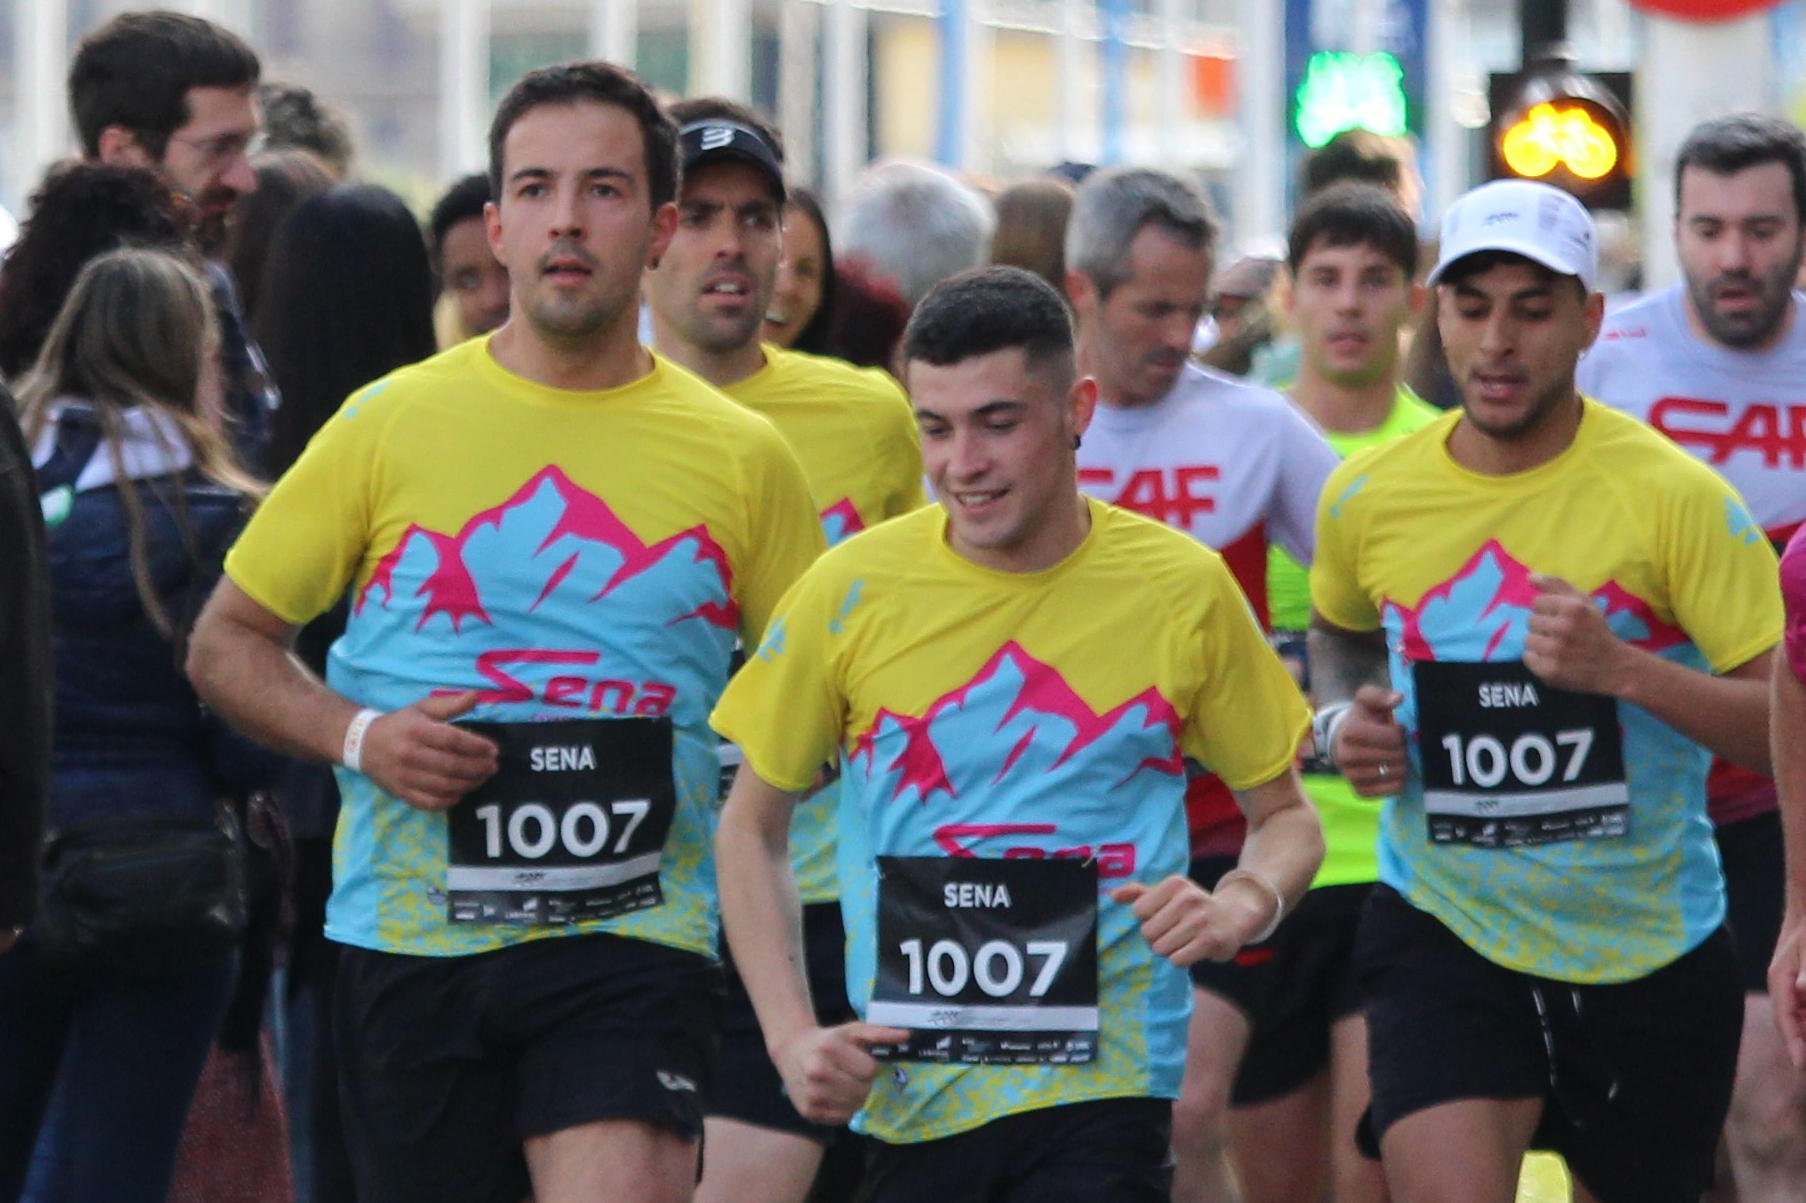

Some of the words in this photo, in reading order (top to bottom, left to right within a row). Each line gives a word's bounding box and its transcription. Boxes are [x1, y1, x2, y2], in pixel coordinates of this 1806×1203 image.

[1077, 465, 1220, 529] AF
[431, 649, 678, 716] Sena
[1478, 682, 1539, 708] SENA
[530, 745, 596, 771] SENA
[1442, 729, 1595, 788] 1007
[475, 798, 651, 860] 1007
[943, 882, 1011, 908] SENA
[899, 938, 1068, 998] 1007
